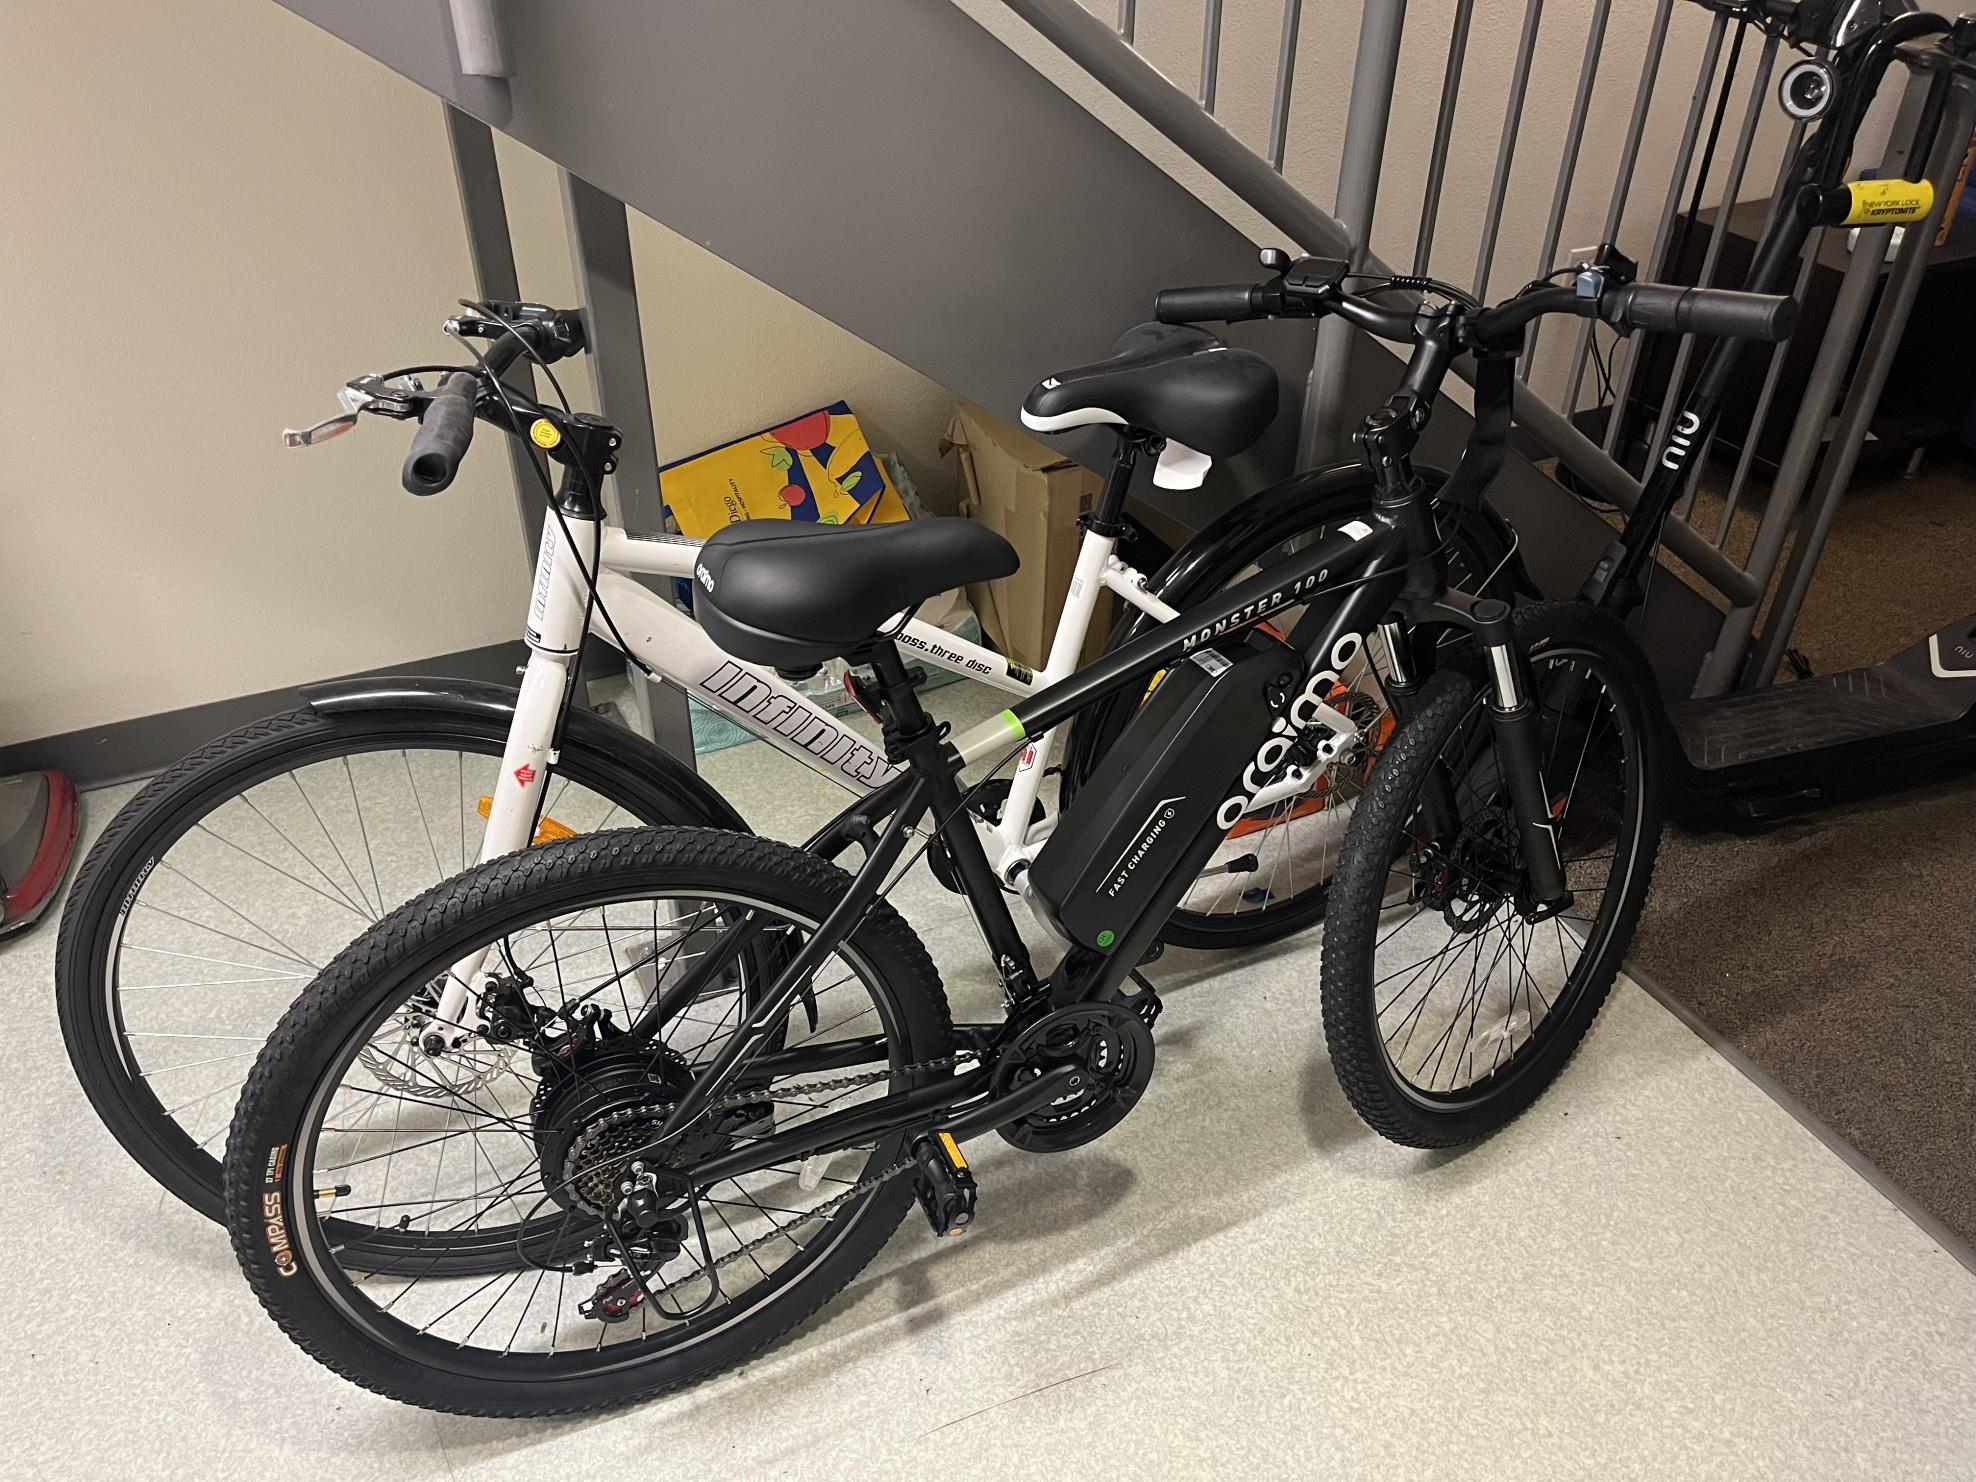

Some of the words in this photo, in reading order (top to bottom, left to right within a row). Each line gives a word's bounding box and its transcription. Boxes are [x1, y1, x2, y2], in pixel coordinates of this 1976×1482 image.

[1870, 206, 1916, 216] KRYPTONITE
[1881, 199, 1900, 207] YORK
[723, 496, 742, 524] Diego
[1182, 591, 1283, 653] MONSTER
[1293, 568, 1329, 595] 100
[964, 658, 992, 676] disc
[1108, 870, 1129, 897] FAST
[1127, 818, 1167, 870] CHARGING
[263, 1191, 298, 1276] COMPASS
